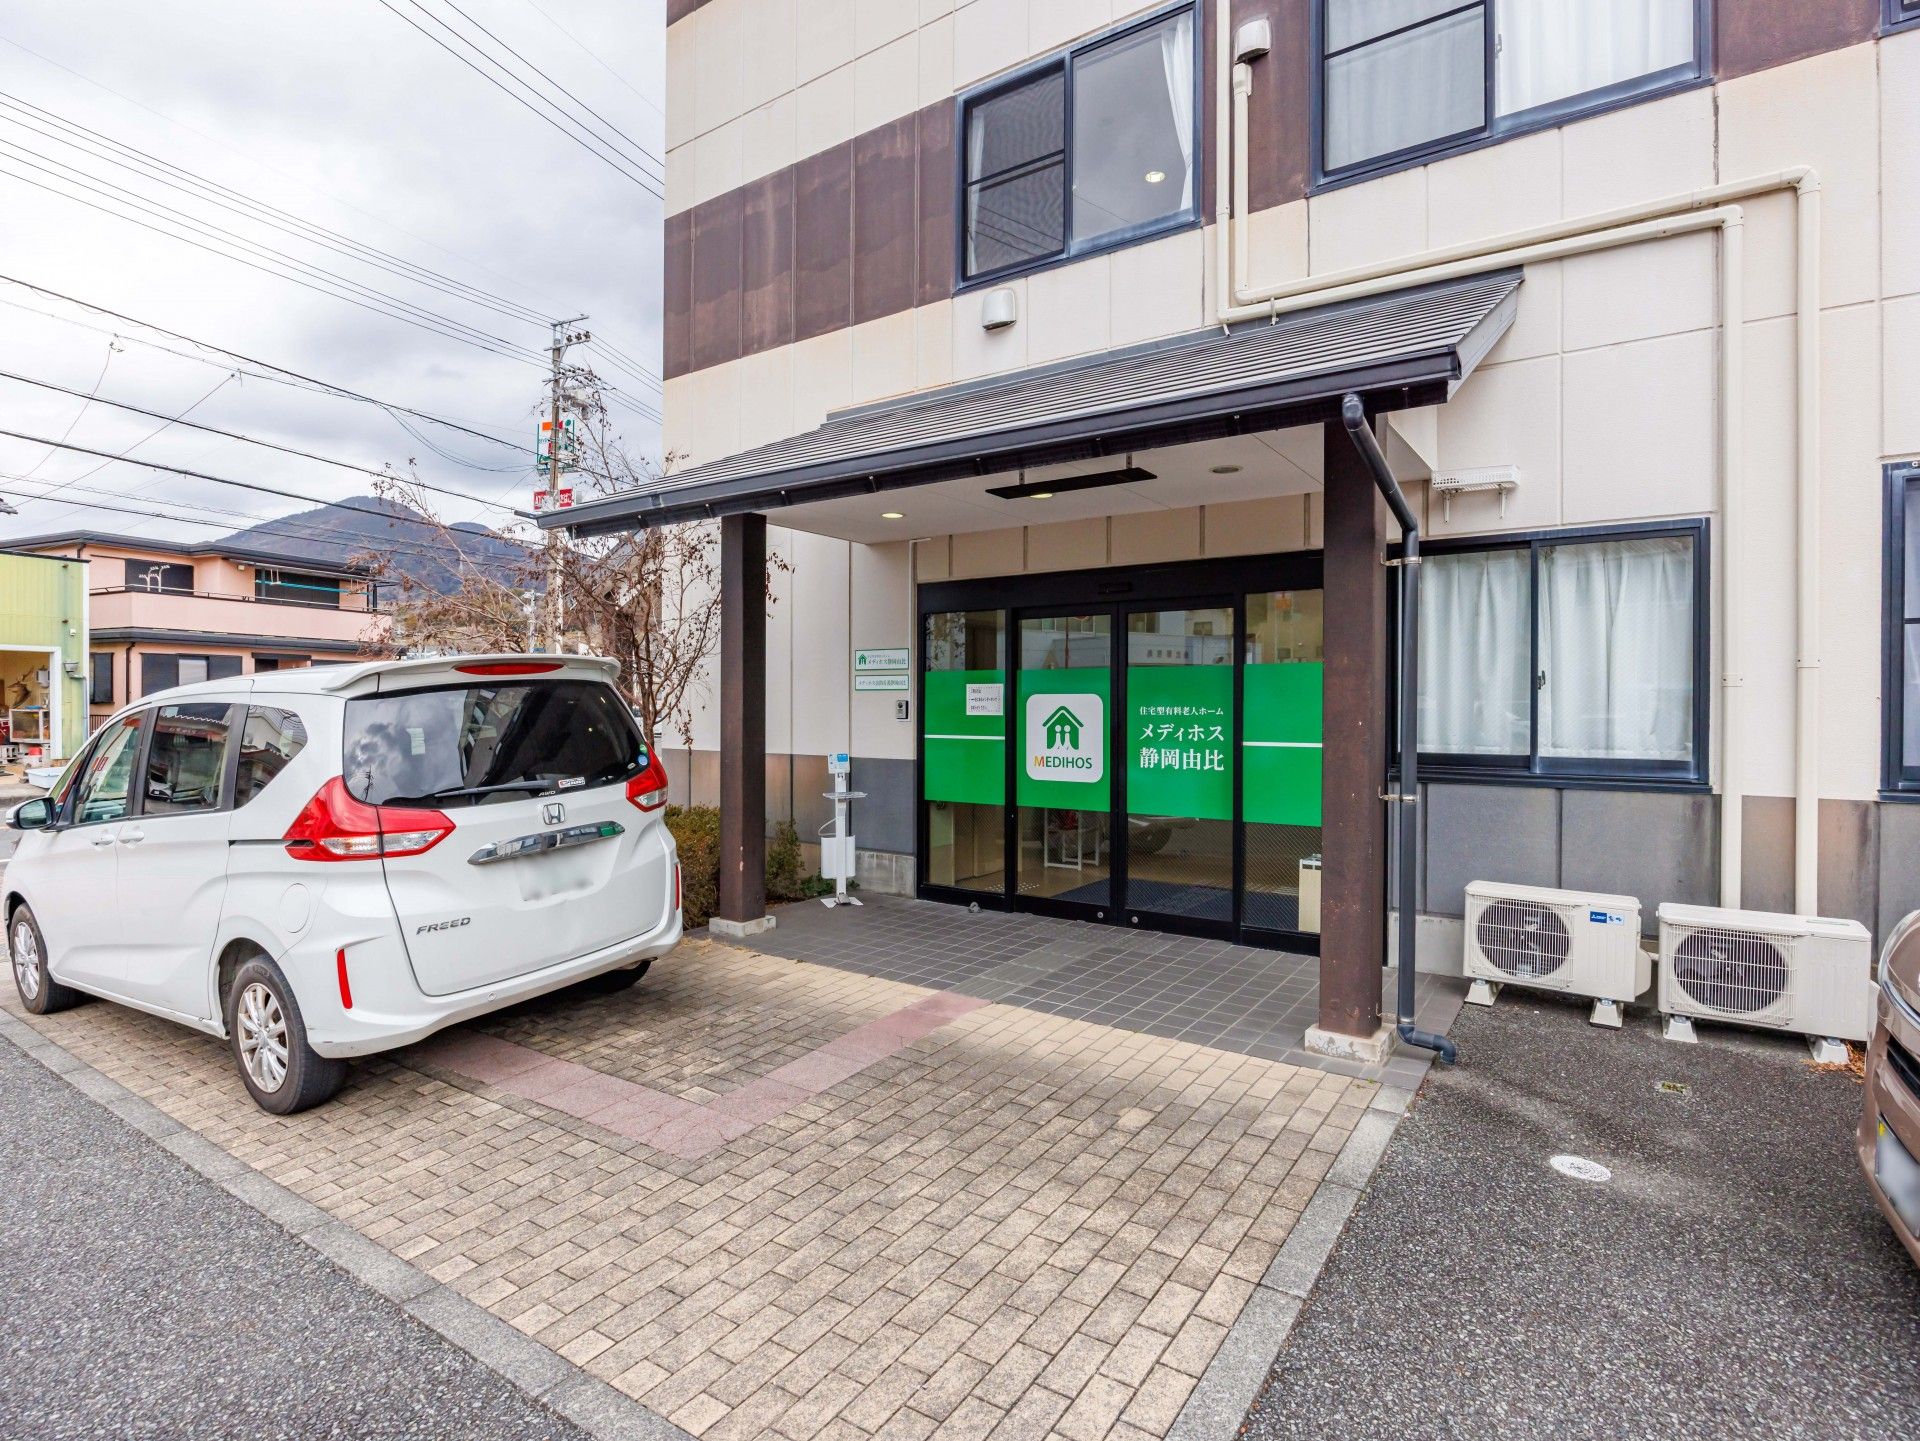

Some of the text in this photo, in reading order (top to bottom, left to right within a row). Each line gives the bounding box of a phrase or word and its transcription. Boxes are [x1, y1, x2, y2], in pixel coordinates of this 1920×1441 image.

[1139, 706, 1224, 716] 住宅型有料老人ホーム
[1139, 723, 1225, 742] メディホス
[1033, 755, 1093, 769] MEDIHOS
[1139, 747, 1225, 771] 静岡由比
[415, 917, 471, 935] FREED
